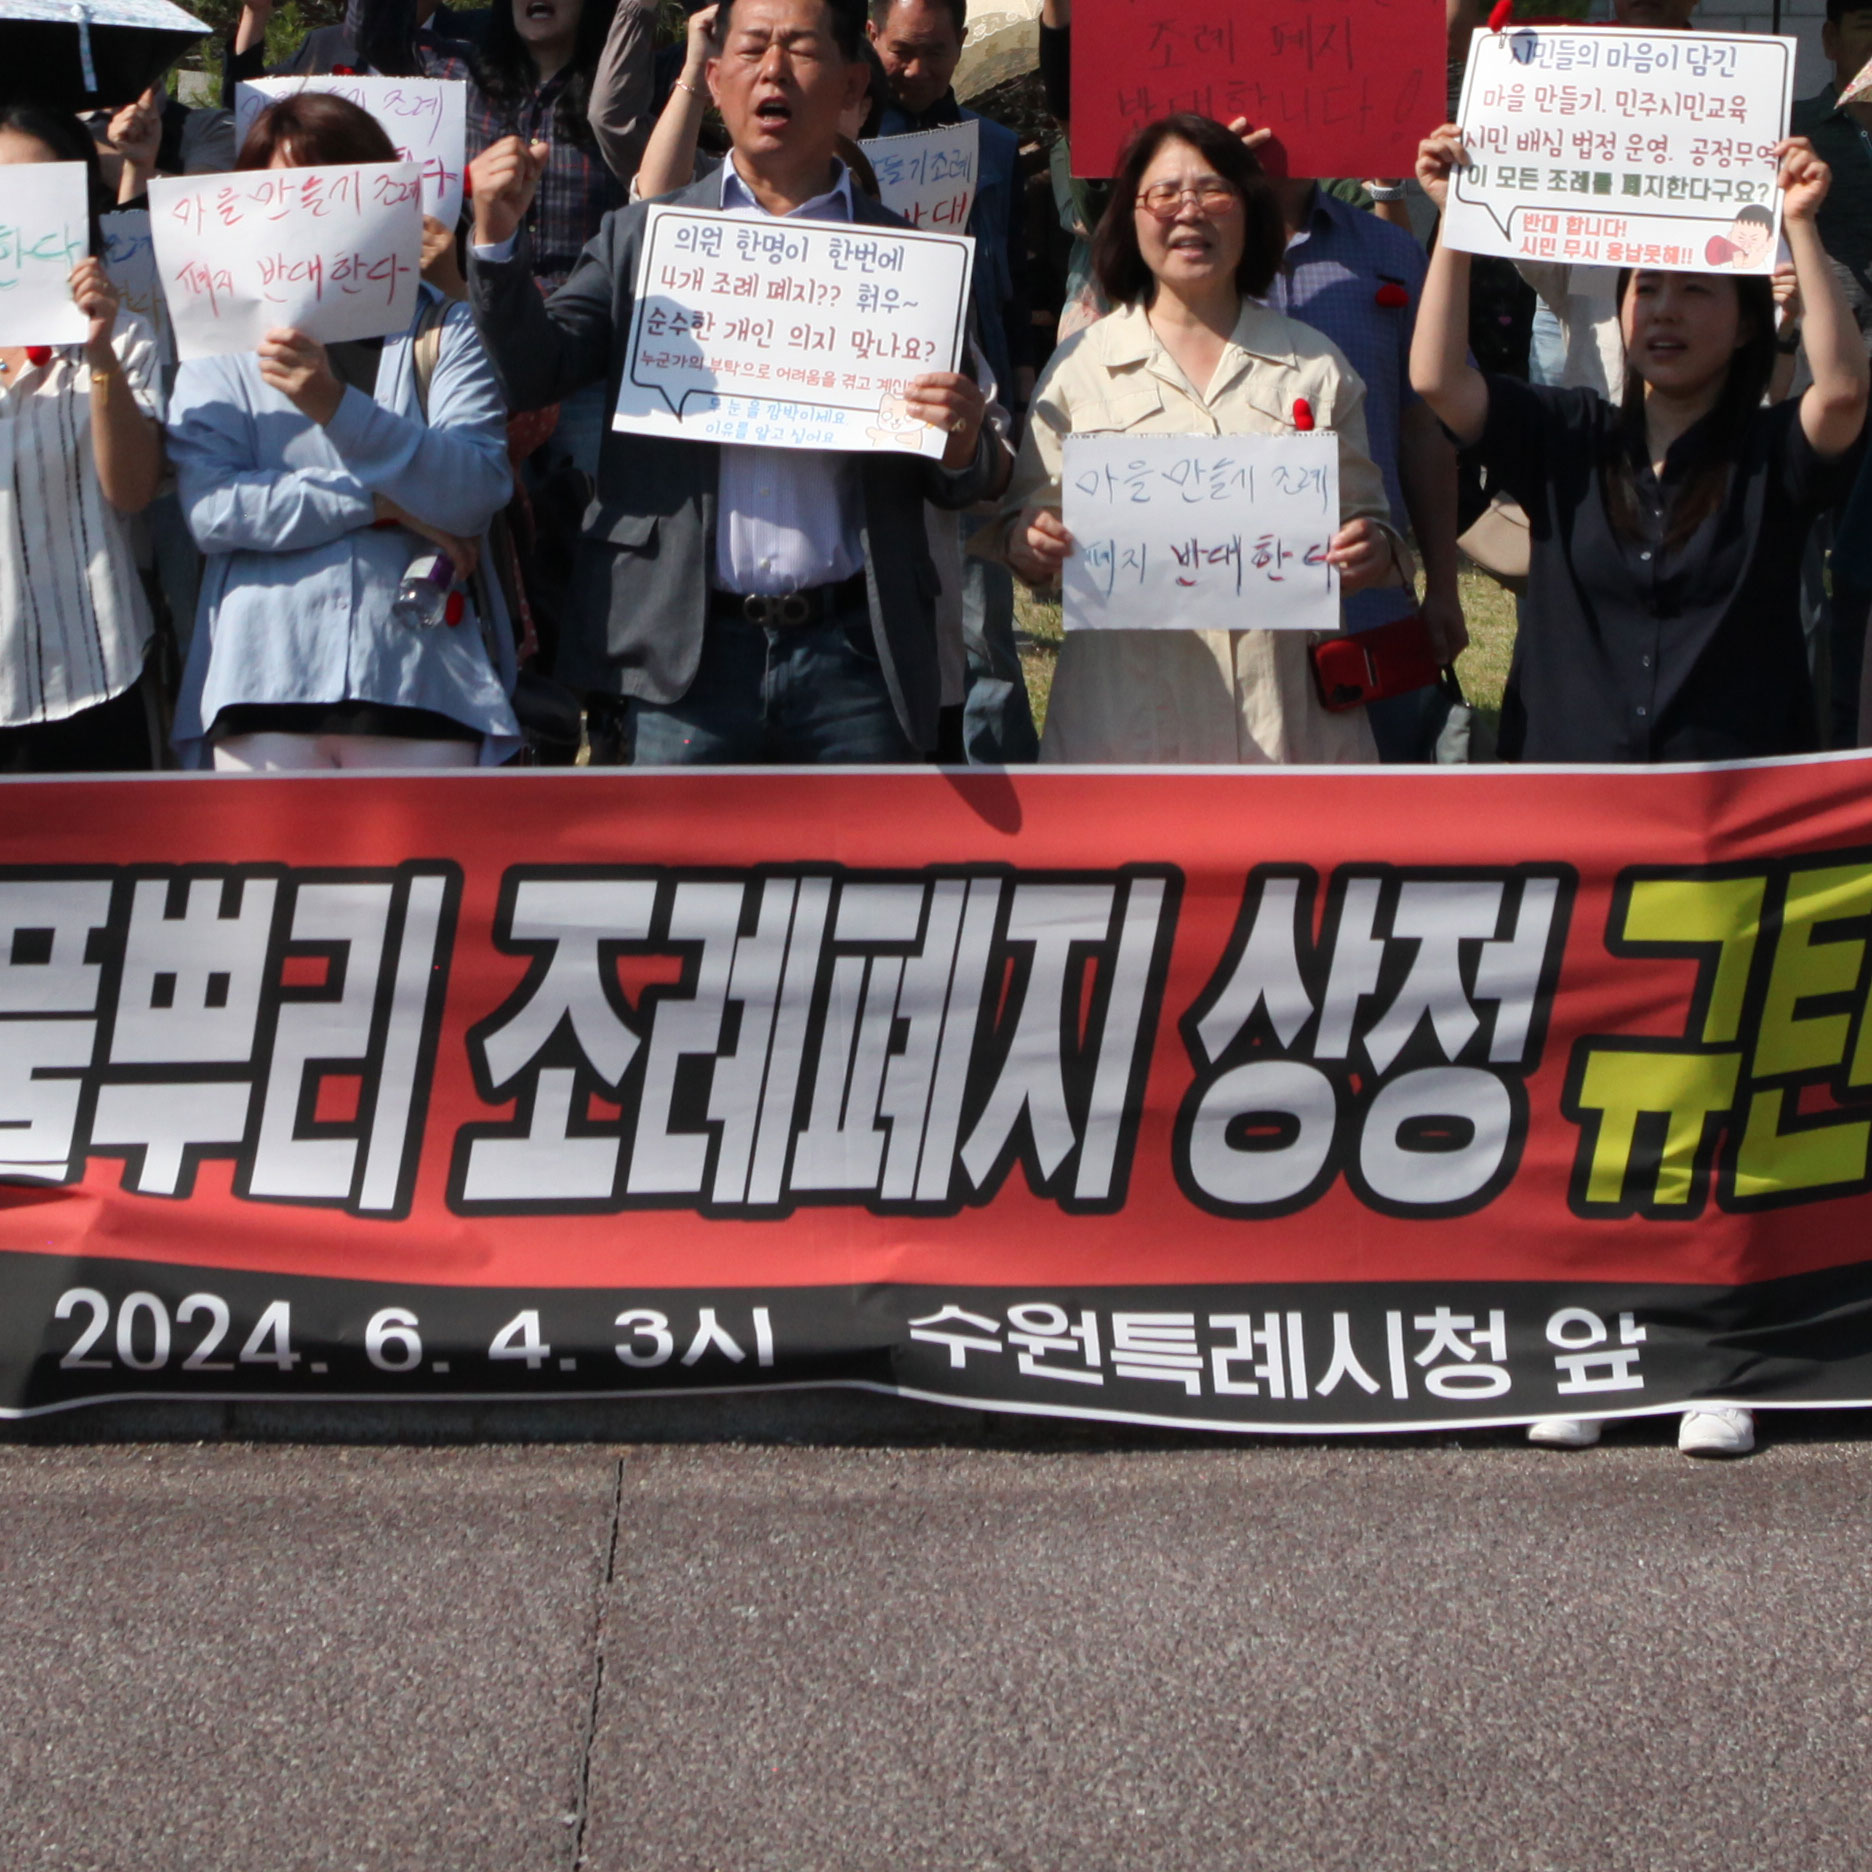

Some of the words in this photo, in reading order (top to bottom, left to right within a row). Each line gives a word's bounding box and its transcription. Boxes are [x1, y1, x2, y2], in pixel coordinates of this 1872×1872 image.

[1510, 40, 1598, 68] 시민들의
[1607, 42, 1678, 74] 마음이
[1686, 45, 1736, 78] 담긴
[1484, 83, 1526, 112] 마을
[1615, 89, 1748, 124] 민주시민교육
[1463, 125, 1508, 154] 시민
[1516, 128, 1563, 157] 배심
[1572, 131, 1616, 161] 법정
[1689, 137, 1778, 169] 공정무역
[1468, 163, 1487, 187] 이
[1495, 166, 1538, 190] 모든
[1547, 169, 1612, 195] 조례를
[1523, 213, 1558, 234] 반대
[1566, 216, 1628, 238] 합니다!
[675, 226, 723, 258] 의원
[736, 230, 809, 264] 한명이
[828, 238, 905, 273] 한번에
[1520, 237, 1556, 257] 시민
[1563, 241, 1599, 259] 무시
[661, 266, 704, 291] 4개
[711, 273, 759, 297] 조례
[766, 277, 841, 305] 폐지??
[647, 307, 715, 338] 순수한
[724, 319, 774, 347] 개인
[789, 324, 836, 351] 의지
[851, 331, 936, 362] 맞나요?
[462, 877, 1167, 1206] 조례폐지
[1188, 877, 1558, 1206] 상정
[53, 1286, 329, 1373] 2024.
[364, 1306, 450, 1373] 6.
[487, 1311, 577, 1372] 4.
[614, 1306, 775, 1369] 3시
[907, 1304, 1508, 1399] 수원특례시청
[1543, 1306, 1645, 1392] 앞
